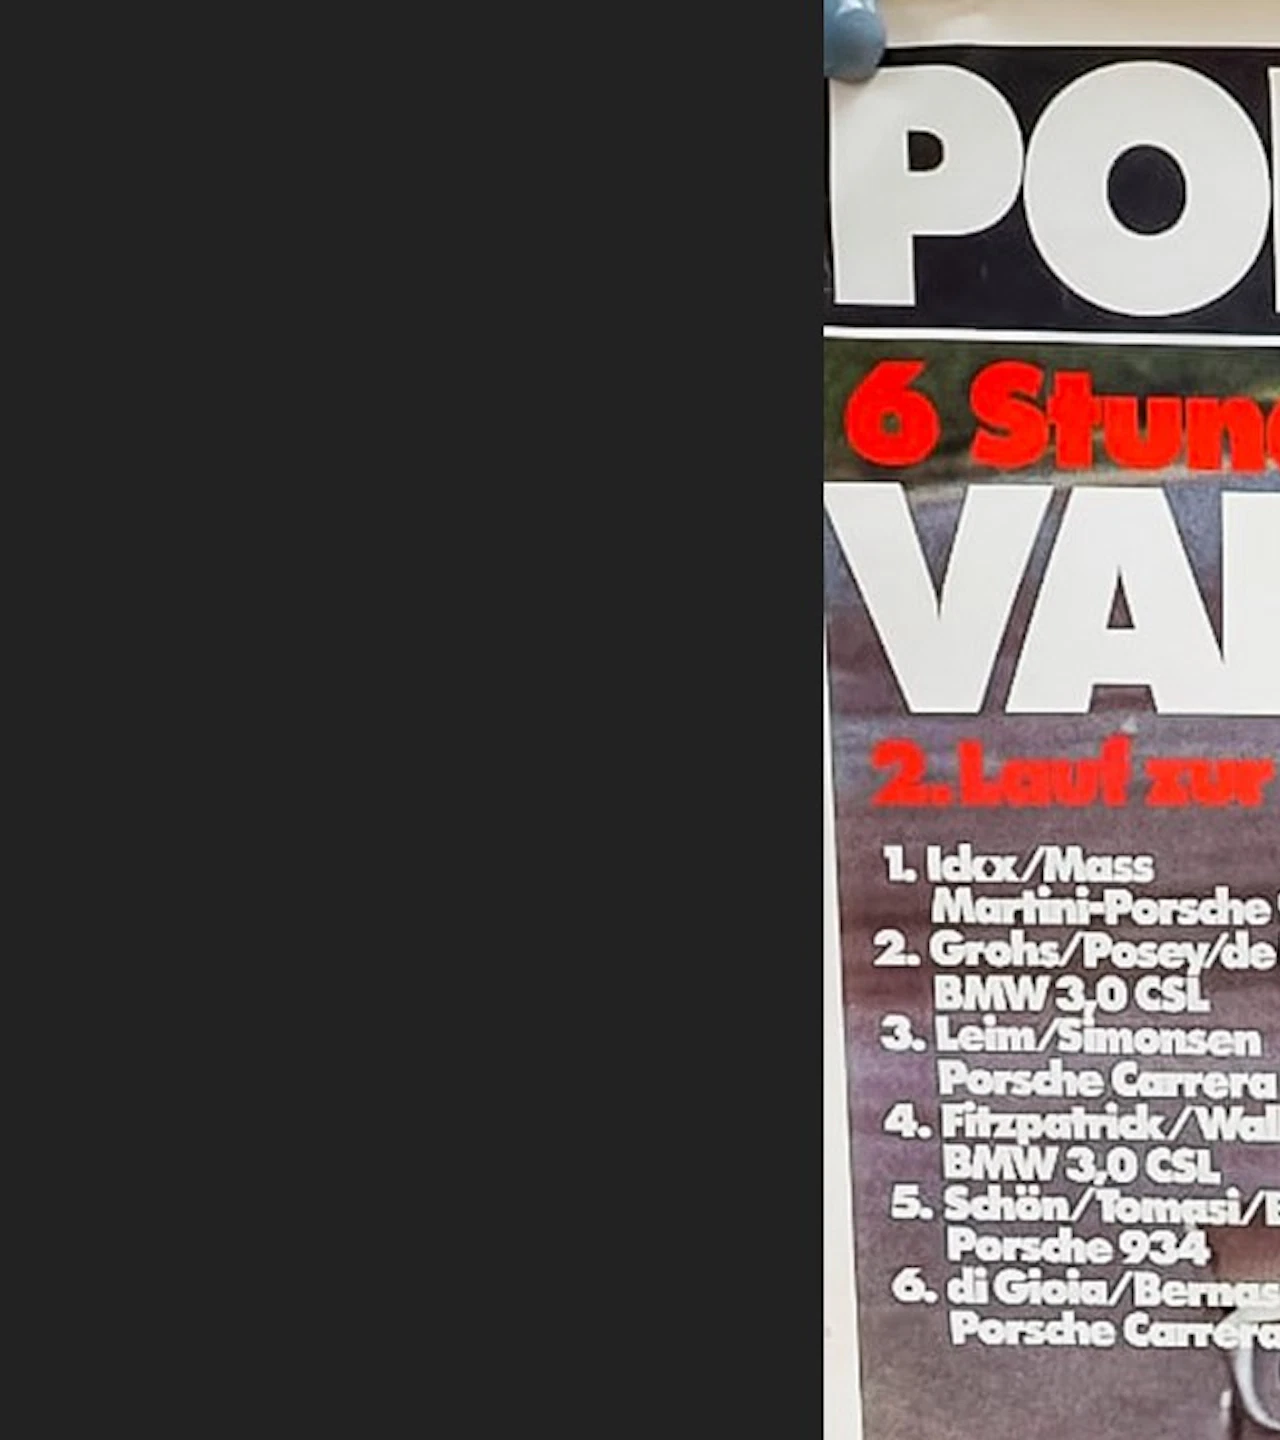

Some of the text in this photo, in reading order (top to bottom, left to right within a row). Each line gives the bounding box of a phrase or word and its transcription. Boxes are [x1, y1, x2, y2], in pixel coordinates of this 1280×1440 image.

[844, 359, 940, 466] 6
[1145, 757, 1274, 807] zur
[884, 844, 1155, 885] 1. Ickx/Mass
[930, 886, 1271, 926] Martini-Porsche
[873, 929, 920, 967] 2.
[934, 974, 1211, 1020] BMW 3,0 CSL
[881, 1015, 1262, 1057] 3. Leim/Simonsen
[938, 1058, 1104, 1097] Porsche
[1111, 1062, 1277, 1099] Carrera
[884, 1103, 932, 1138] 4.
[943, 1145, 1221, 1191] BMW 3,0 CSL
[890, 1185, 933, 1221] 5.
[947, 1227, 1211, 1266] Porsche 934
[892, 1269, 937, 1304] 6.
[947, 1271, 988, 1306] di
[950, 1311, 1114, 1348] Porsche
